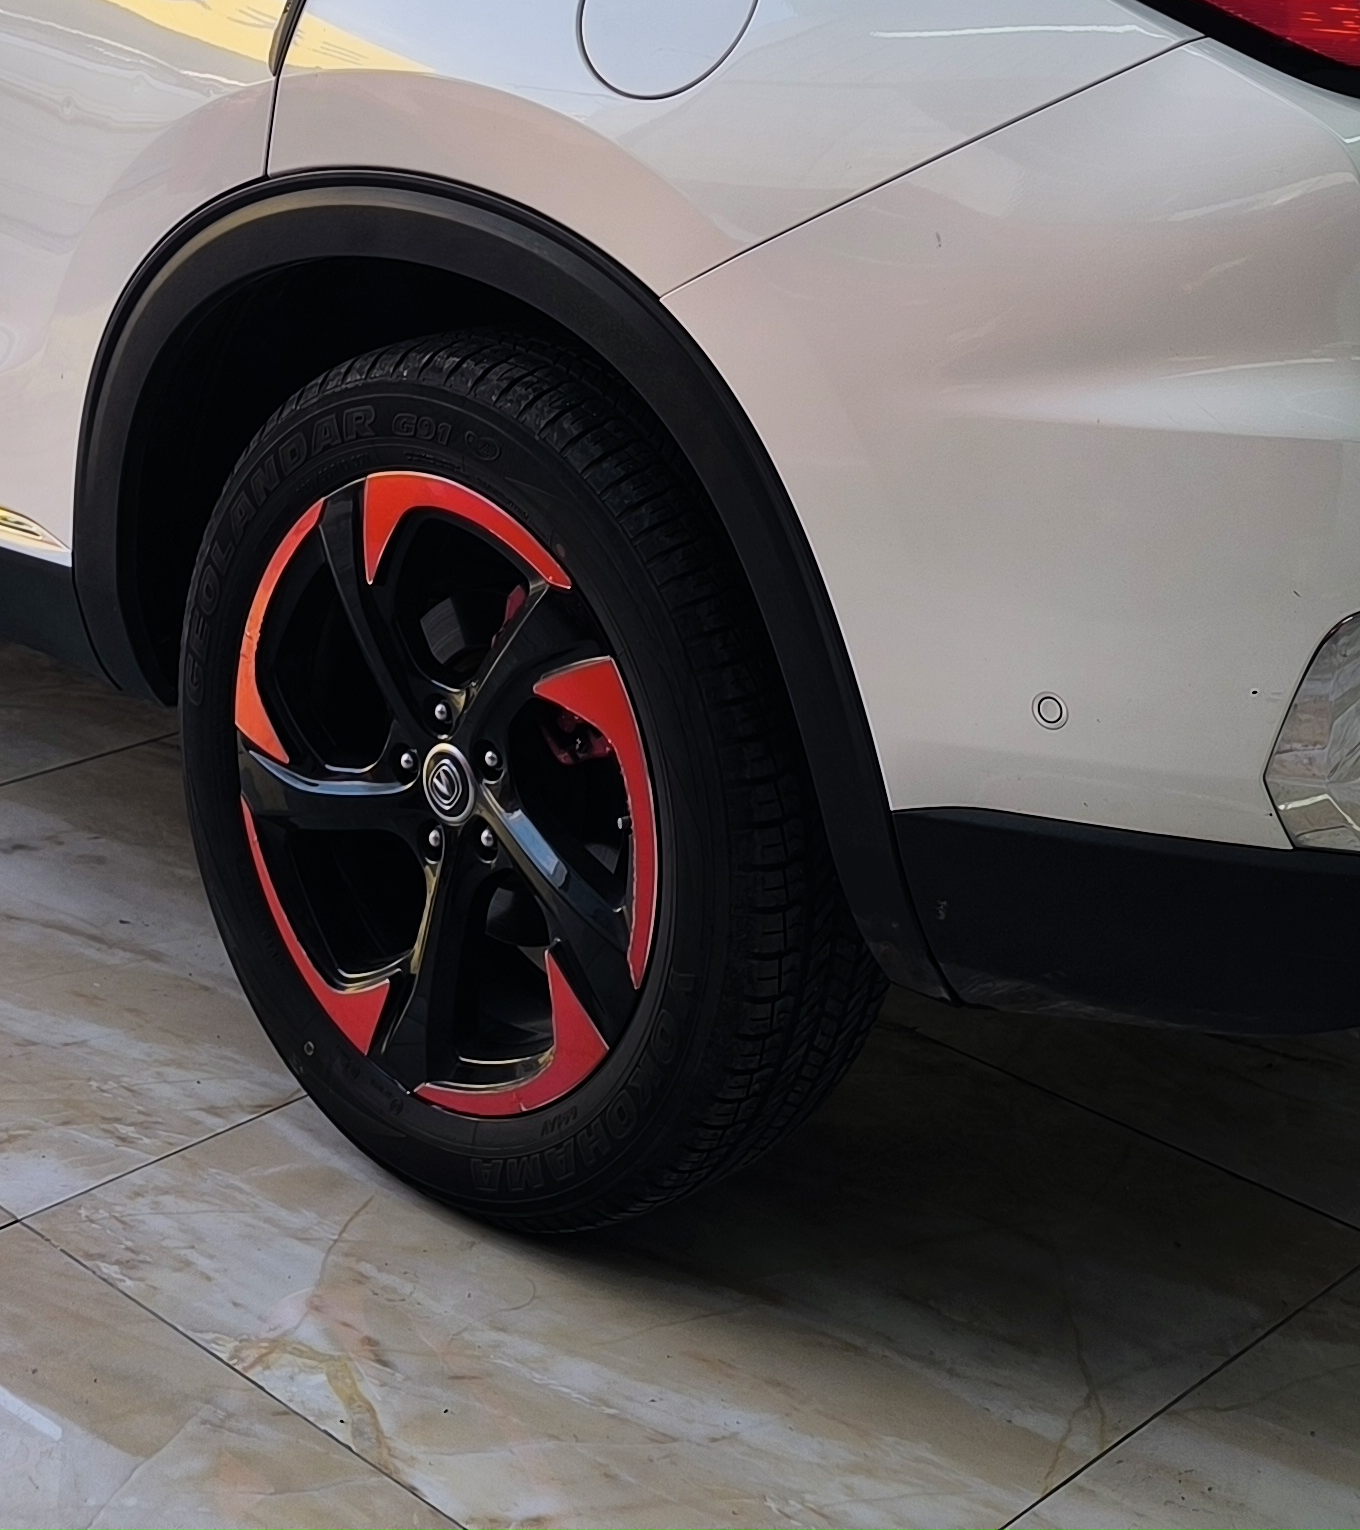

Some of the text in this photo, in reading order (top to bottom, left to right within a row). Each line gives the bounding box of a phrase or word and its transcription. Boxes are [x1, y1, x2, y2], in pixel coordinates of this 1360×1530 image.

[185, 405, 453, 707] GEOLANDAR G91
[469, 968, 696, 1193] YOKOHAMA
